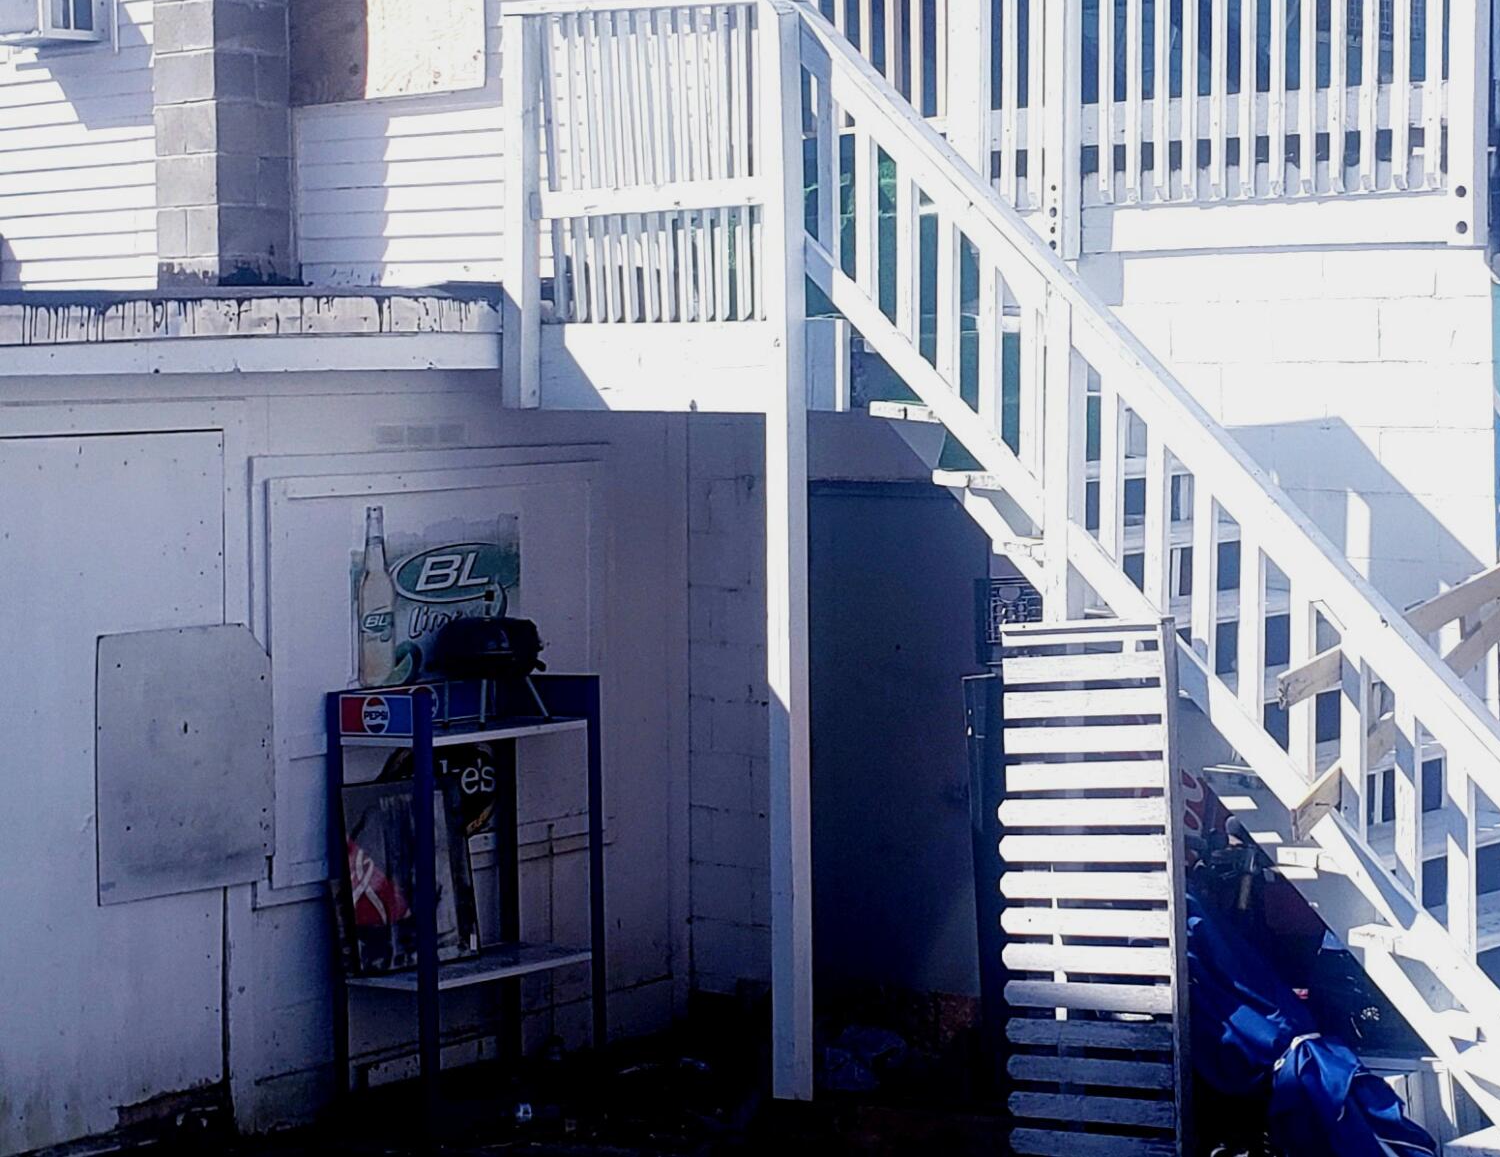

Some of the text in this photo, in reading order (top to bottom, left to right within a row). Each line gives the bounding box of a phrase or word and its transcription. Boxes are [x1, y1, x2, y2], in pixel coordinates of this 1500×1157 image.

[415, 551, 490, 593] BL
[365, 614, 388, 627] BL
[364, 711, 388, 720] PEPSI
